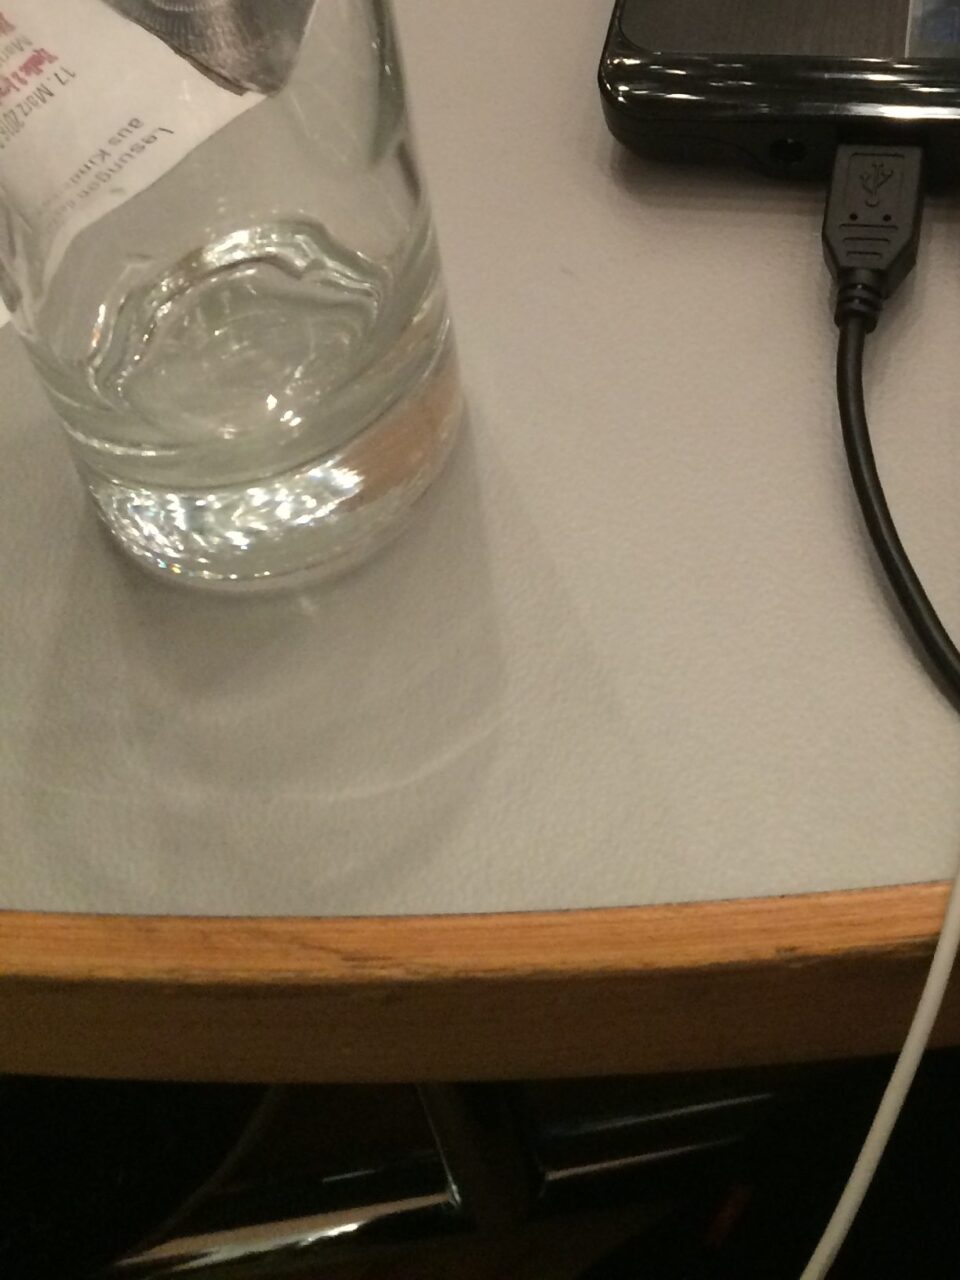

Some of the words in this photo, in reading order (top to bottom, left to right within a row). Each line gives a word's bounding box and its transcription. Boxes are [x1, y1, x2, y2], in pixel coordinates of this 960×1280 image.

[46, 67, 76, 86] 17.
[106, 116, 144, 148] aus
[76, 127, 174, 198] Lesungen
